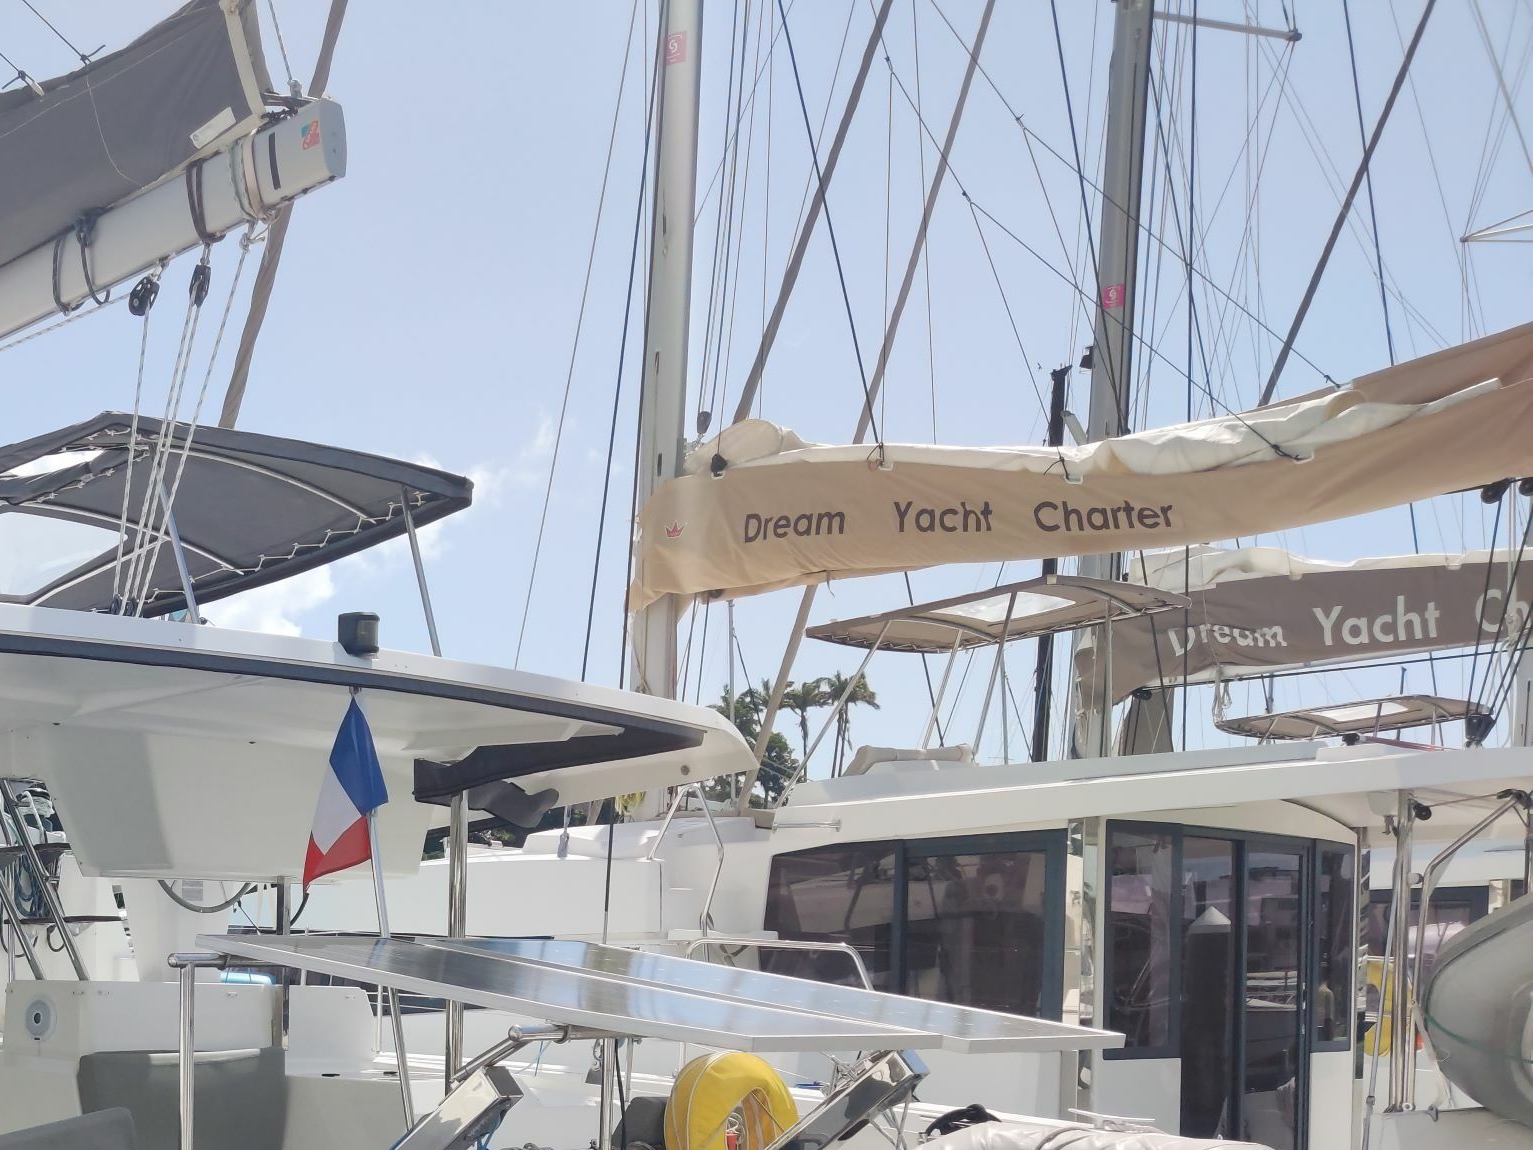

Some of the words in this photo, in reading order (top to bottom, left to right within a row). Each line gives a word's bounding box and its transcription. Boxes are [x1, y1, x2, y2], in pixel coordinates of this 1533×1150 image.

[744, 510, 846, 544] Dream
[893, 500, 993, 534] Yacht
[1033, 499, 1174, 534] Charter
[1167, 622, 1287, 657] Dream
[1312, 595, 1441, 647] Yacht
